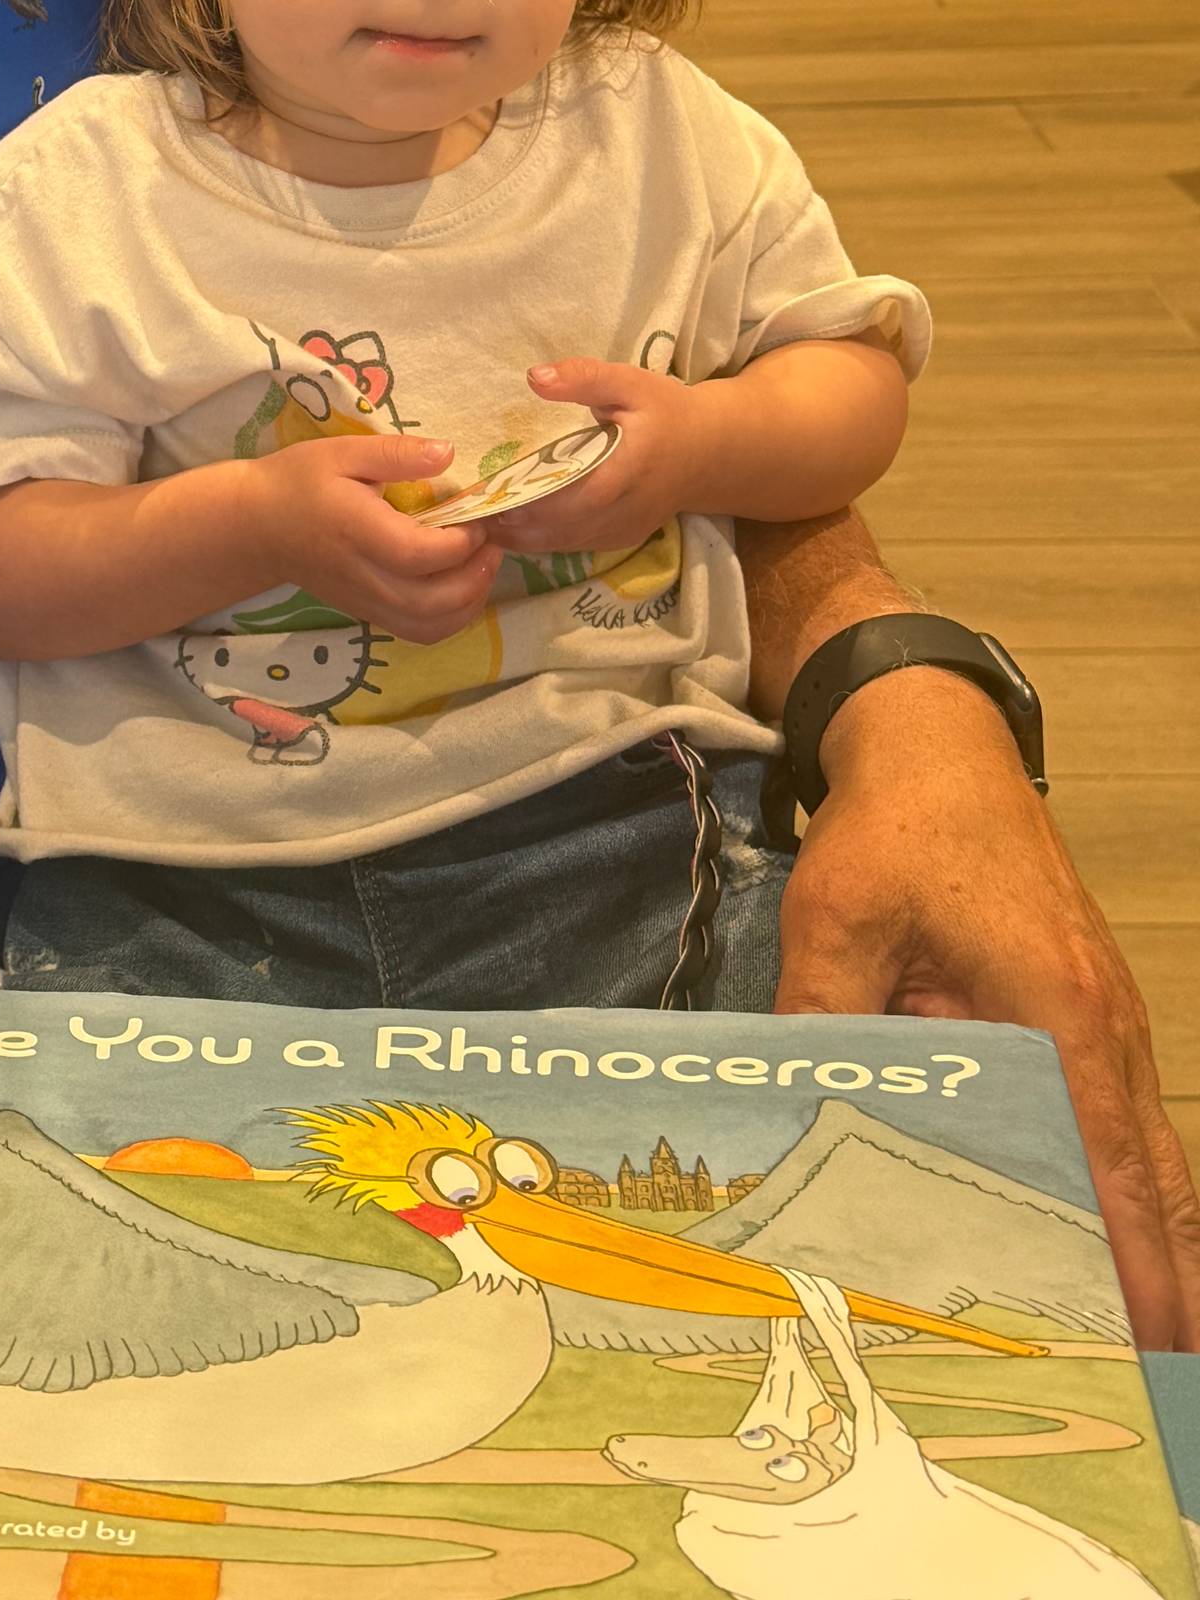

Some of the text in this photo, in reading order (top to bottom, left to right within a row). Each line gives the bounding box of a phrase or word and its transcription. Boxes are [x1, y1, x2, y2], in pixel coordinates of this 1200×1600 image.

[569, 587, 625, 630] Hello
[69, 1016, 252, 1065] You
[283, 1040, 345, 1068] a
[374, 1025, 981, 1098] Rhinoceros?
[96, 1519, 137, 1547] by
